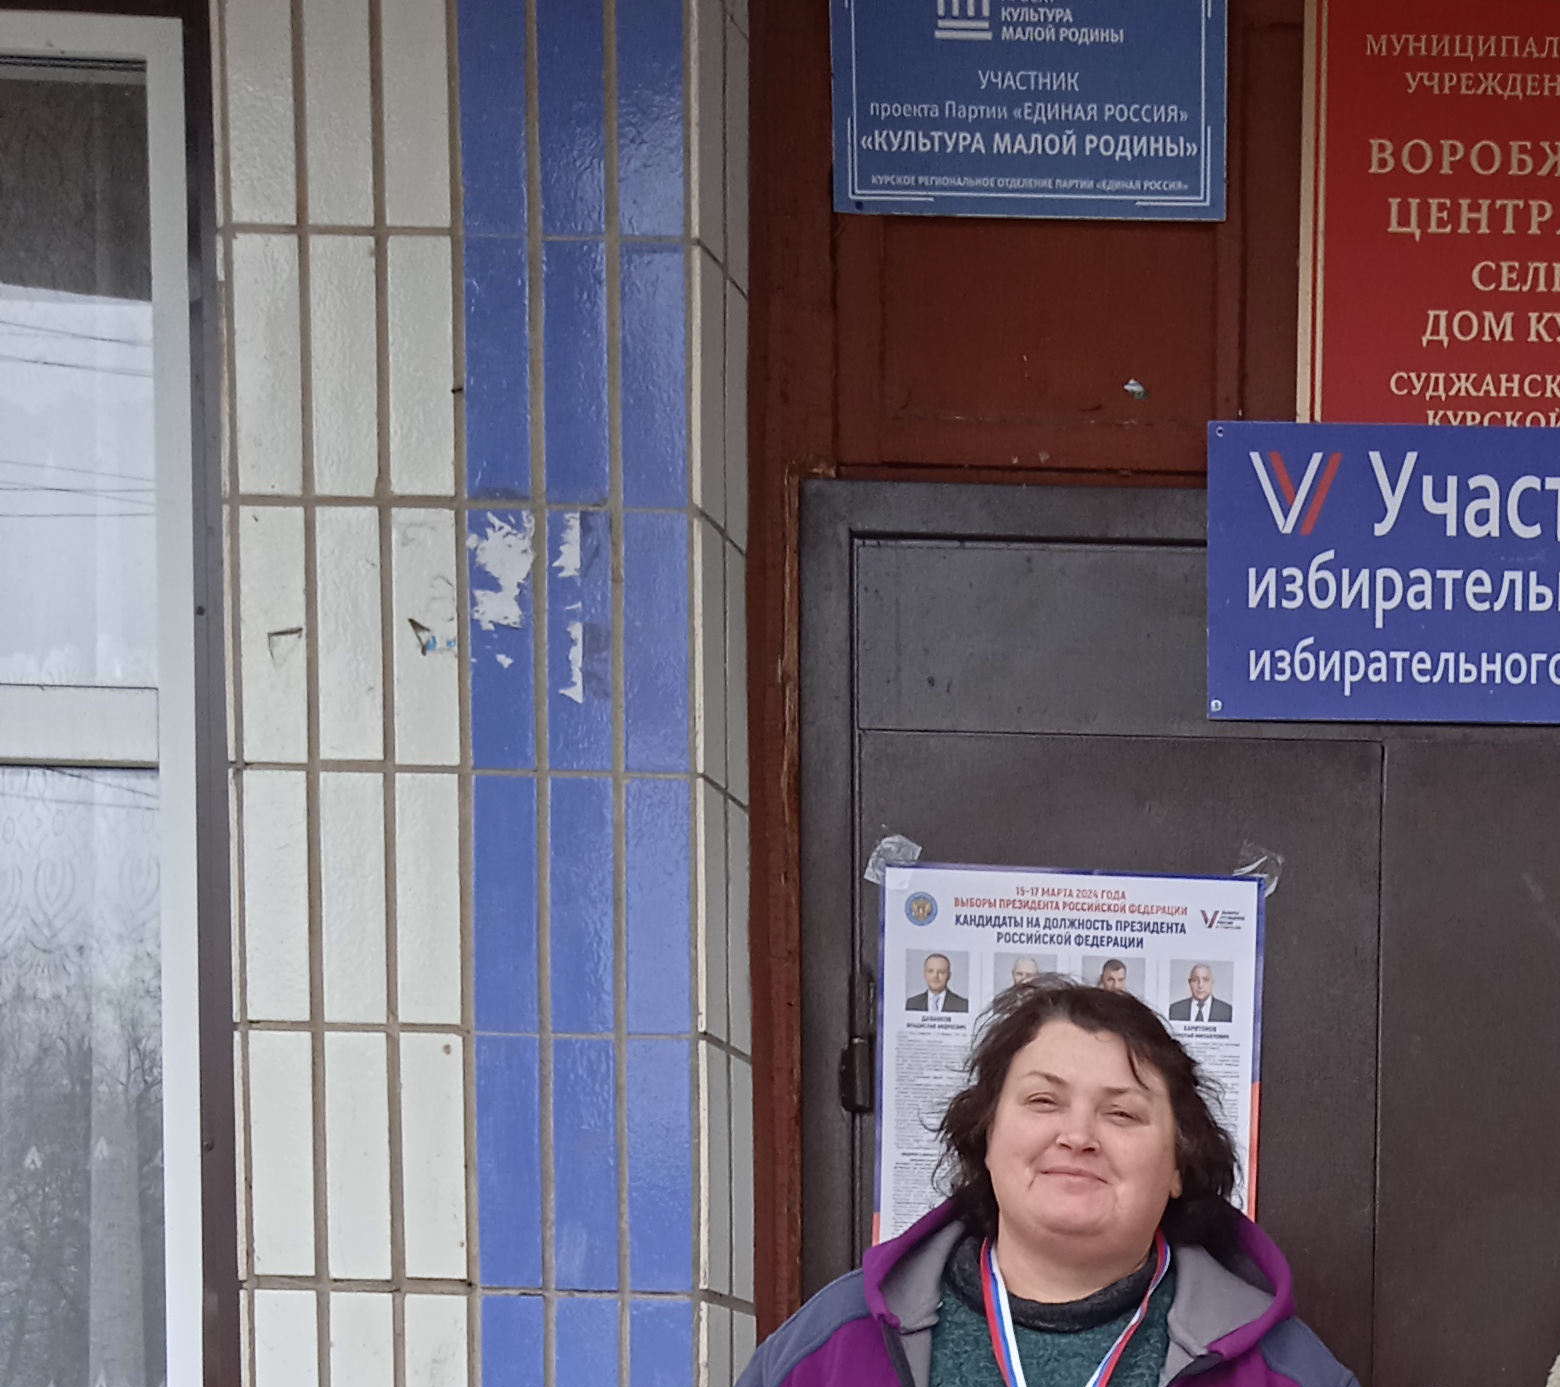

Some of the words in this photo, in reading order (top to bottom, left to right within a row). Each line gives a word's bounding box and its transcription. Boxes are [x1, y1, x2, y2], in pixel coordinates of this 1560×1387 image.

[1001, 6, 1073, 22] КУЛЬТУРА
[1001, 24, 1055, 42] МАЛОЙ
[1059, 27, 1124, 45] РОДИНЫ
[978, 69, 1079, 91] УЧАСТНИК
[870, 102, 939, 120] проекта
[945, 101, 1007, 122] Партии
[1013, 102, 1098, 124] «ЕДИНАЯ
[1104, 104, 1188, 122] РОССИЯ»
[861, 129, 985, 154] «КУЛЬТУРА
[993, 129, 1076, 156] МАЛОЙ
[1085, 134, 1198, 161] РОДИНЫ»
[1422, 311, 1514, 347] ДОМ
[1016, 886, 1038, 897] 15-17
[1041, 888, 1073, 898] МАРТА
[1076, 889, 1098, 899] 2024
[1101, 890, 1126, 901] ГОДА
[954, 897, 996, 909] ВЫБОРЫ
[999, 899, 1060, 912] ПРЕЗИДЕНТА
[1063, 900, 1126, 914] РОССИЙСКОЙ
[1129, 904, 1188, 917] ФЕДЕРАЦИИ
[955, 914, 1024, 929] КАНДИДАТЫ
[1027, 917, 1040, 929] НА
[1043, 918, 1113, 932] ДОЛЖНОСТЬ
[1115, 921, 1187, 936] ПРЕЗИДЕНТА
[996, 930, 1071, 946] РОССИЙСКОЙ
[1074, 935, 1144, 950] ФЕДЕРАЦИИ
